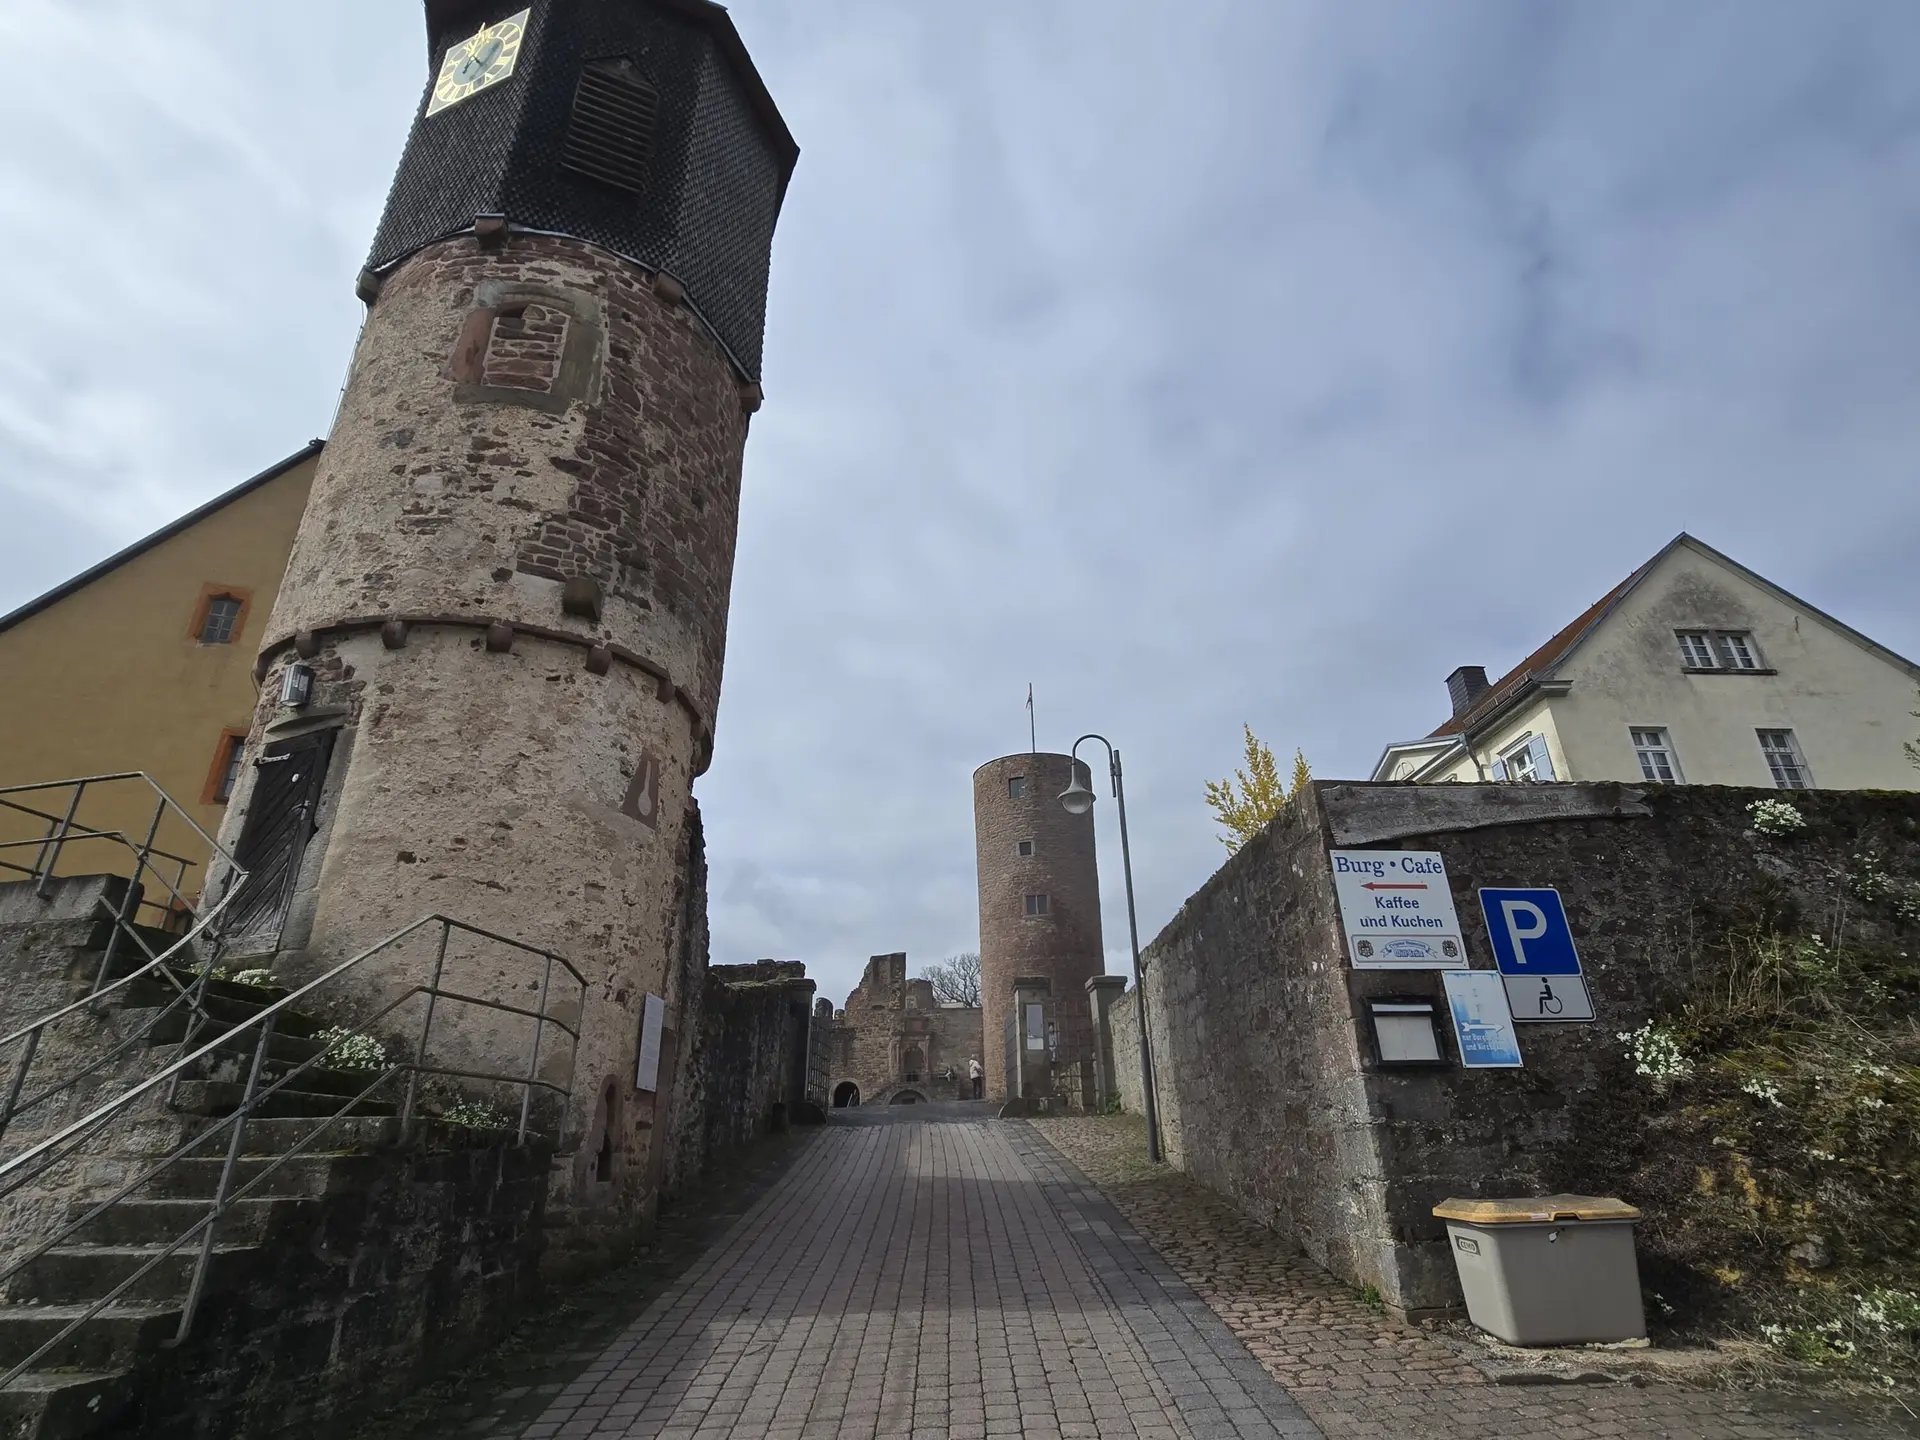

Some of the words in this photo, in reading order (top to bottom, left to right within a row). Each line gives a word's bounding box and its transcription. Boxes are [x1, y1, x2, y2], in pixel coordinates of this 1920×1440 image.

[1335, 857, 1384, 877] Burg
[1401, 857, 1442, 874] Cafe
[1374, 896, 1419, 909] Kaffee
[1360, 915, 1387, 928] und
[1391, 915, 1443, 928] Kuchen
[1500, 900, 1547, 964] P
